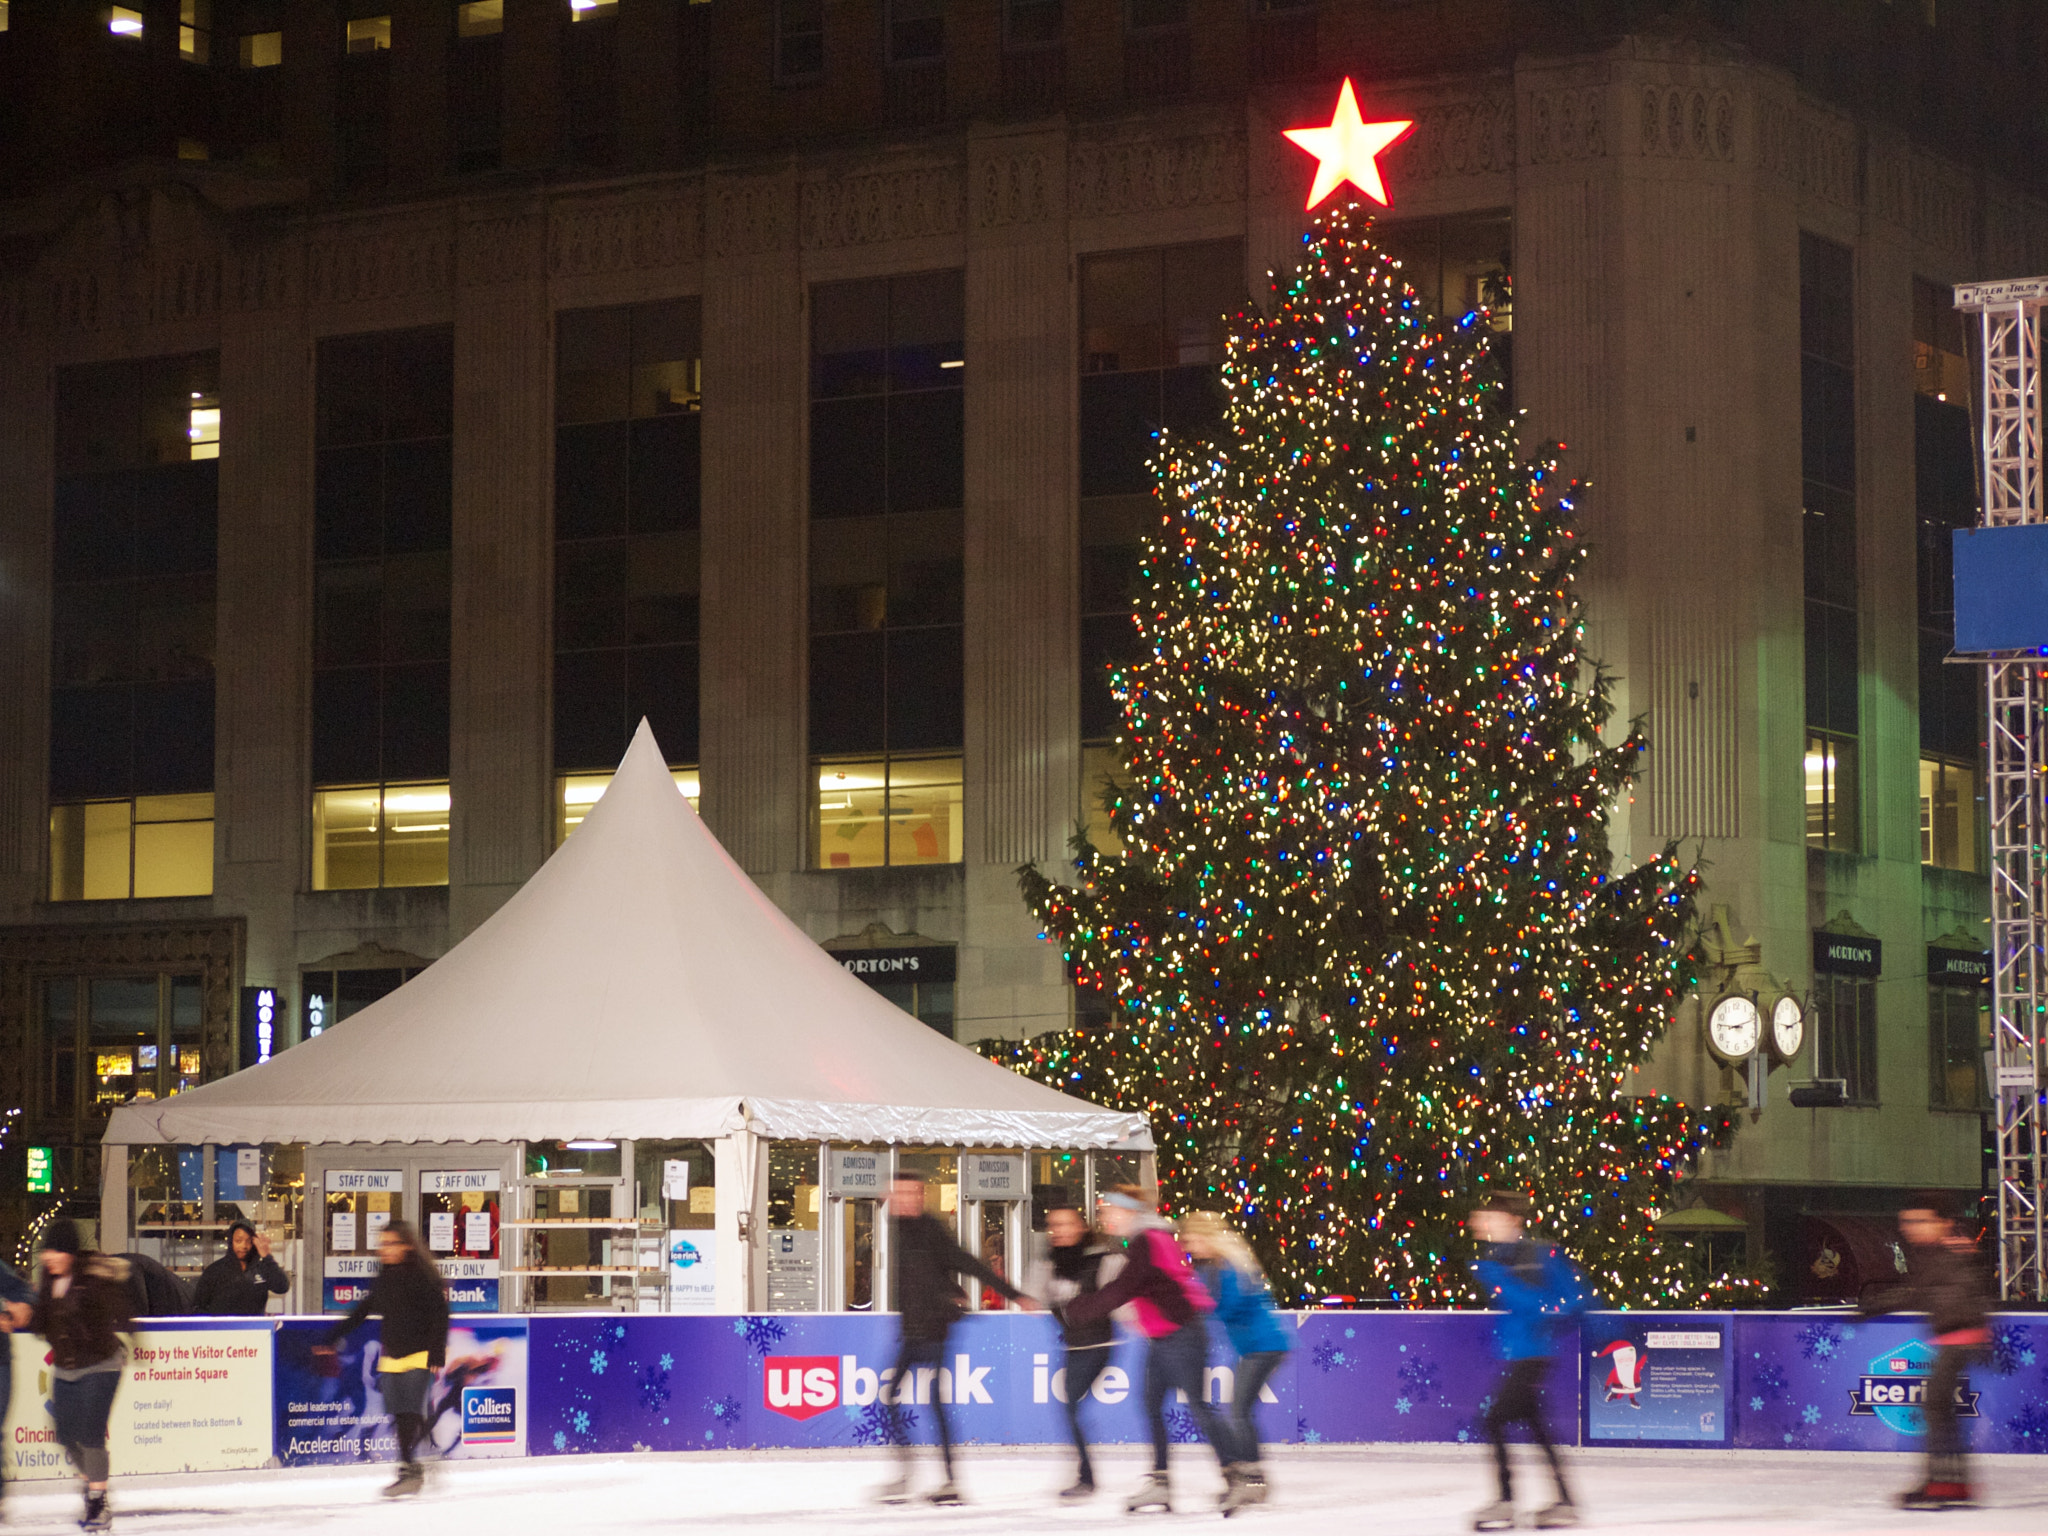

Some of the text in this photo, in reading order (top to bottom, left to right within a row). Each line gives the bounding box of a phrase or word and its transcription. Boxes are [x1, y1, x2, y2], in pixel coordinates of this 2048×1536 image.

[1828, 945, 1872, 963] MORTON'S
[838, 956, 920, 973] ORTON'S
[843, 1156, 876, 1170] ADMISSION
[979, 1160, 1010, 1173] ADMISSION
[339, 1175, 390, 1187] STAFF ONLY
[465, 1175, 487, 1188] ONLY
[842, 1174, 876, 1186] and SKATES
[990, 1177, 1010, 1189] SKATES
[338, 1260, 380, 1272] STAFF ON
[463, 1263, 485, 1276] ONLY
[133, 1346, 258, 1363] Stop by the Visitor Center
[134, 1367, 228, 1383] on Fountain Square
[1864, 1379, 1906, 1402] ice
[133, 1400, 173, 1411] Open daily!
[288, 1401, 351, 1412] Global leadership in
[467, 1398, 512, 1416] Colliers
[133, 1416, 243, 1430] Located between Rock Bottom &
[288, 1416, 325, 1427] commercial
[326, 1416, 339, 1425] real
[340, 1416, 359, 1425] estate
[15, 1426, 57, 1443] Cincin
[133, 1435, 162, 1446] Chipotle
[289, 1437, 397, 1456] Accelerating succe
[16, 1450, 60, 1467] Visitor
